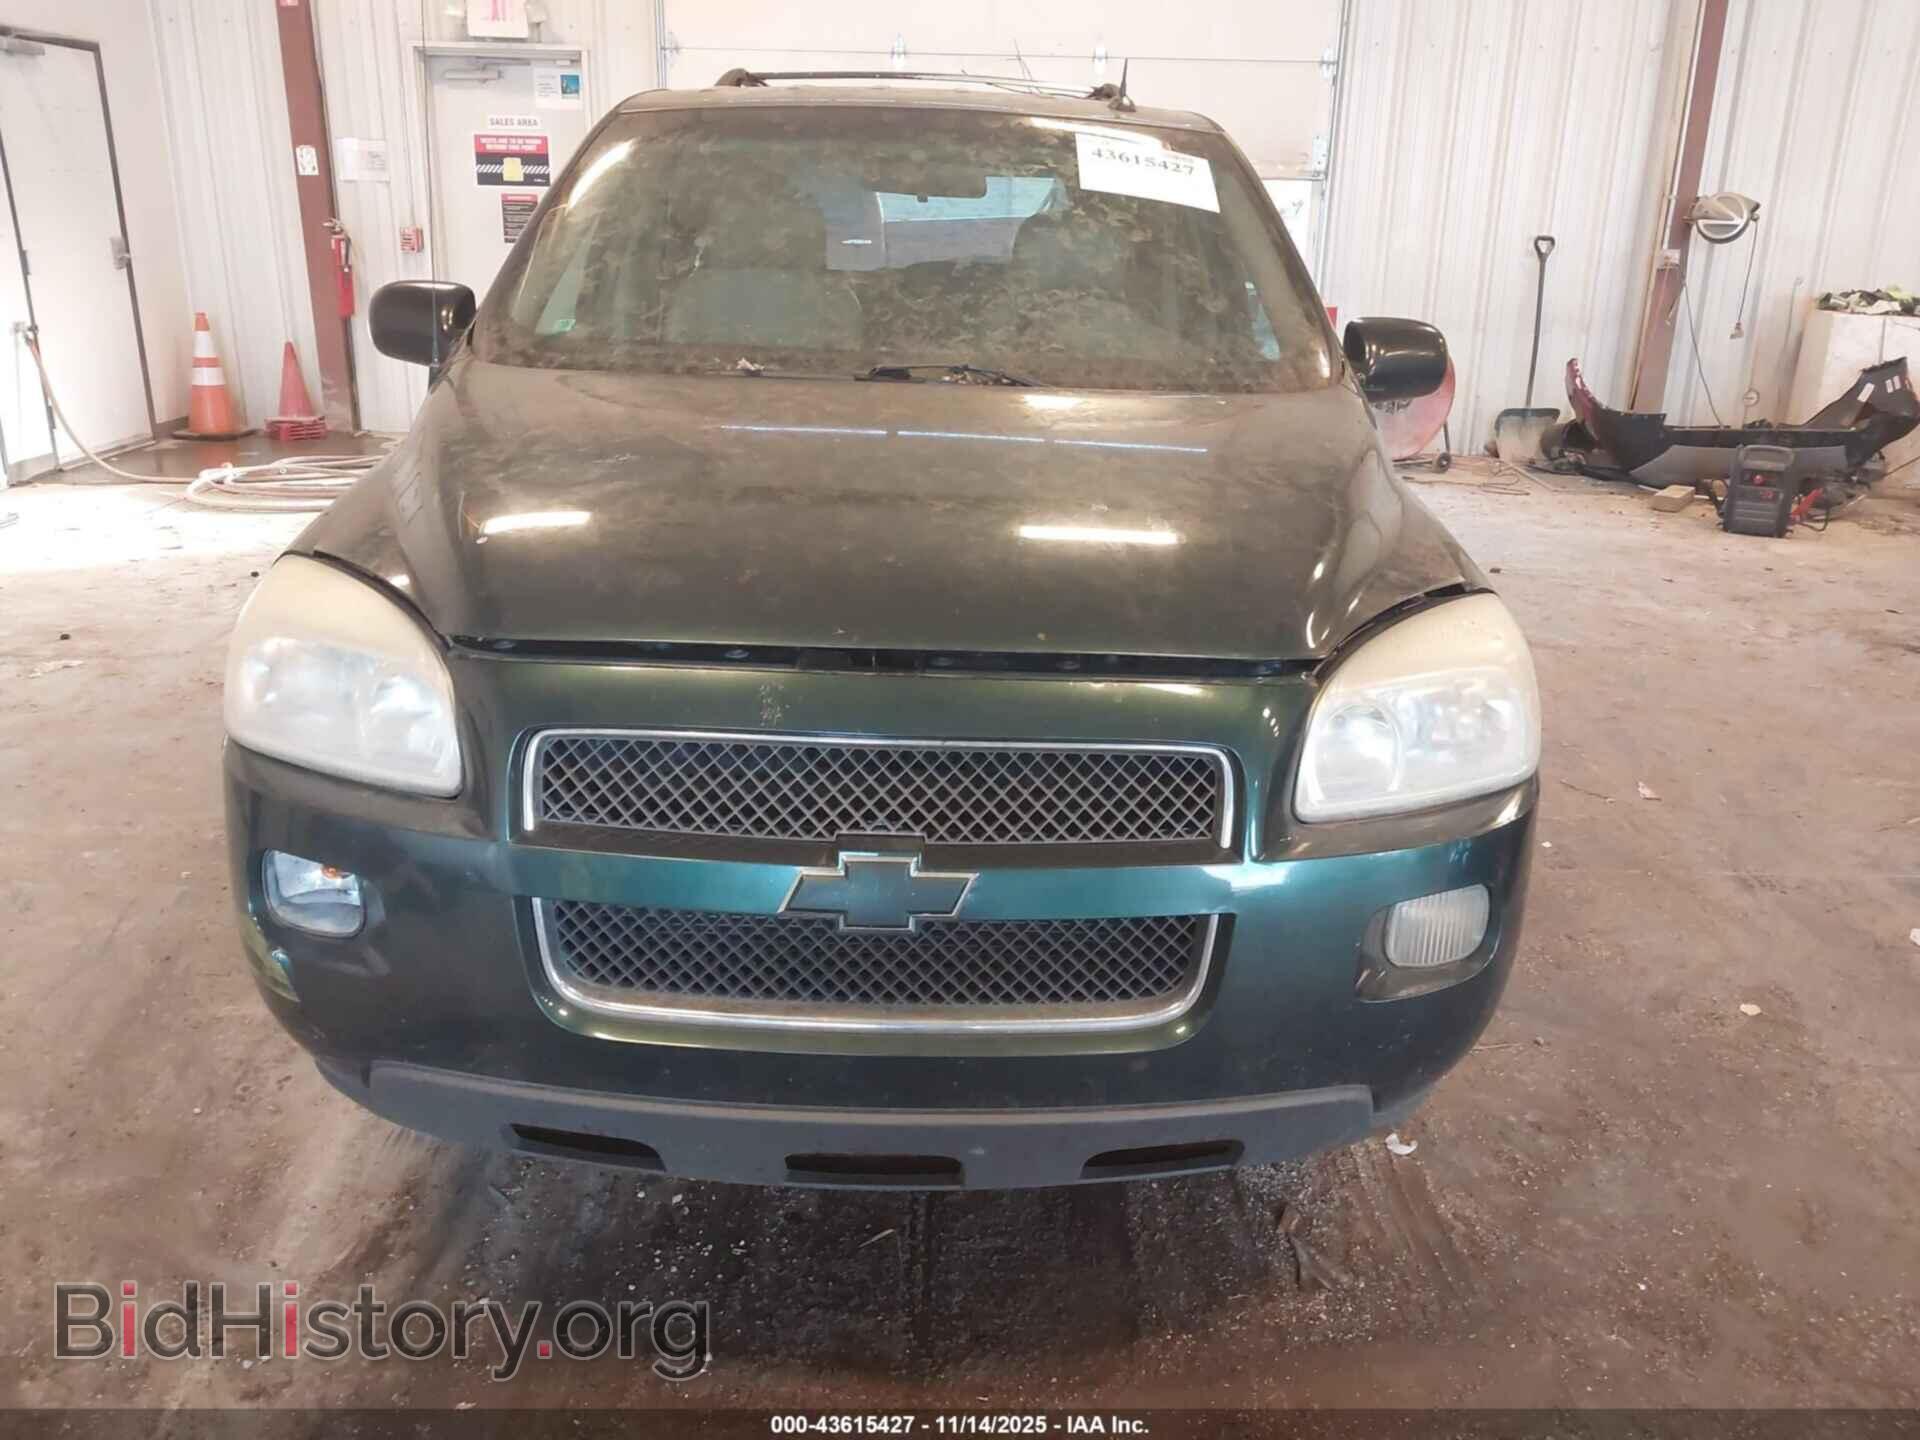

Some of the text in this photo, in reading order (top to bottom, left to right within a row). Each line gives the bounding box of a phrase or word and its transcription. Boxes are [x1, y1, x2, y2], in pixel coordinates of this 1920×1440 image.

[489, 117, 539, 127] SALES AREA
[1091, 147, 1195, 175] 43615427
